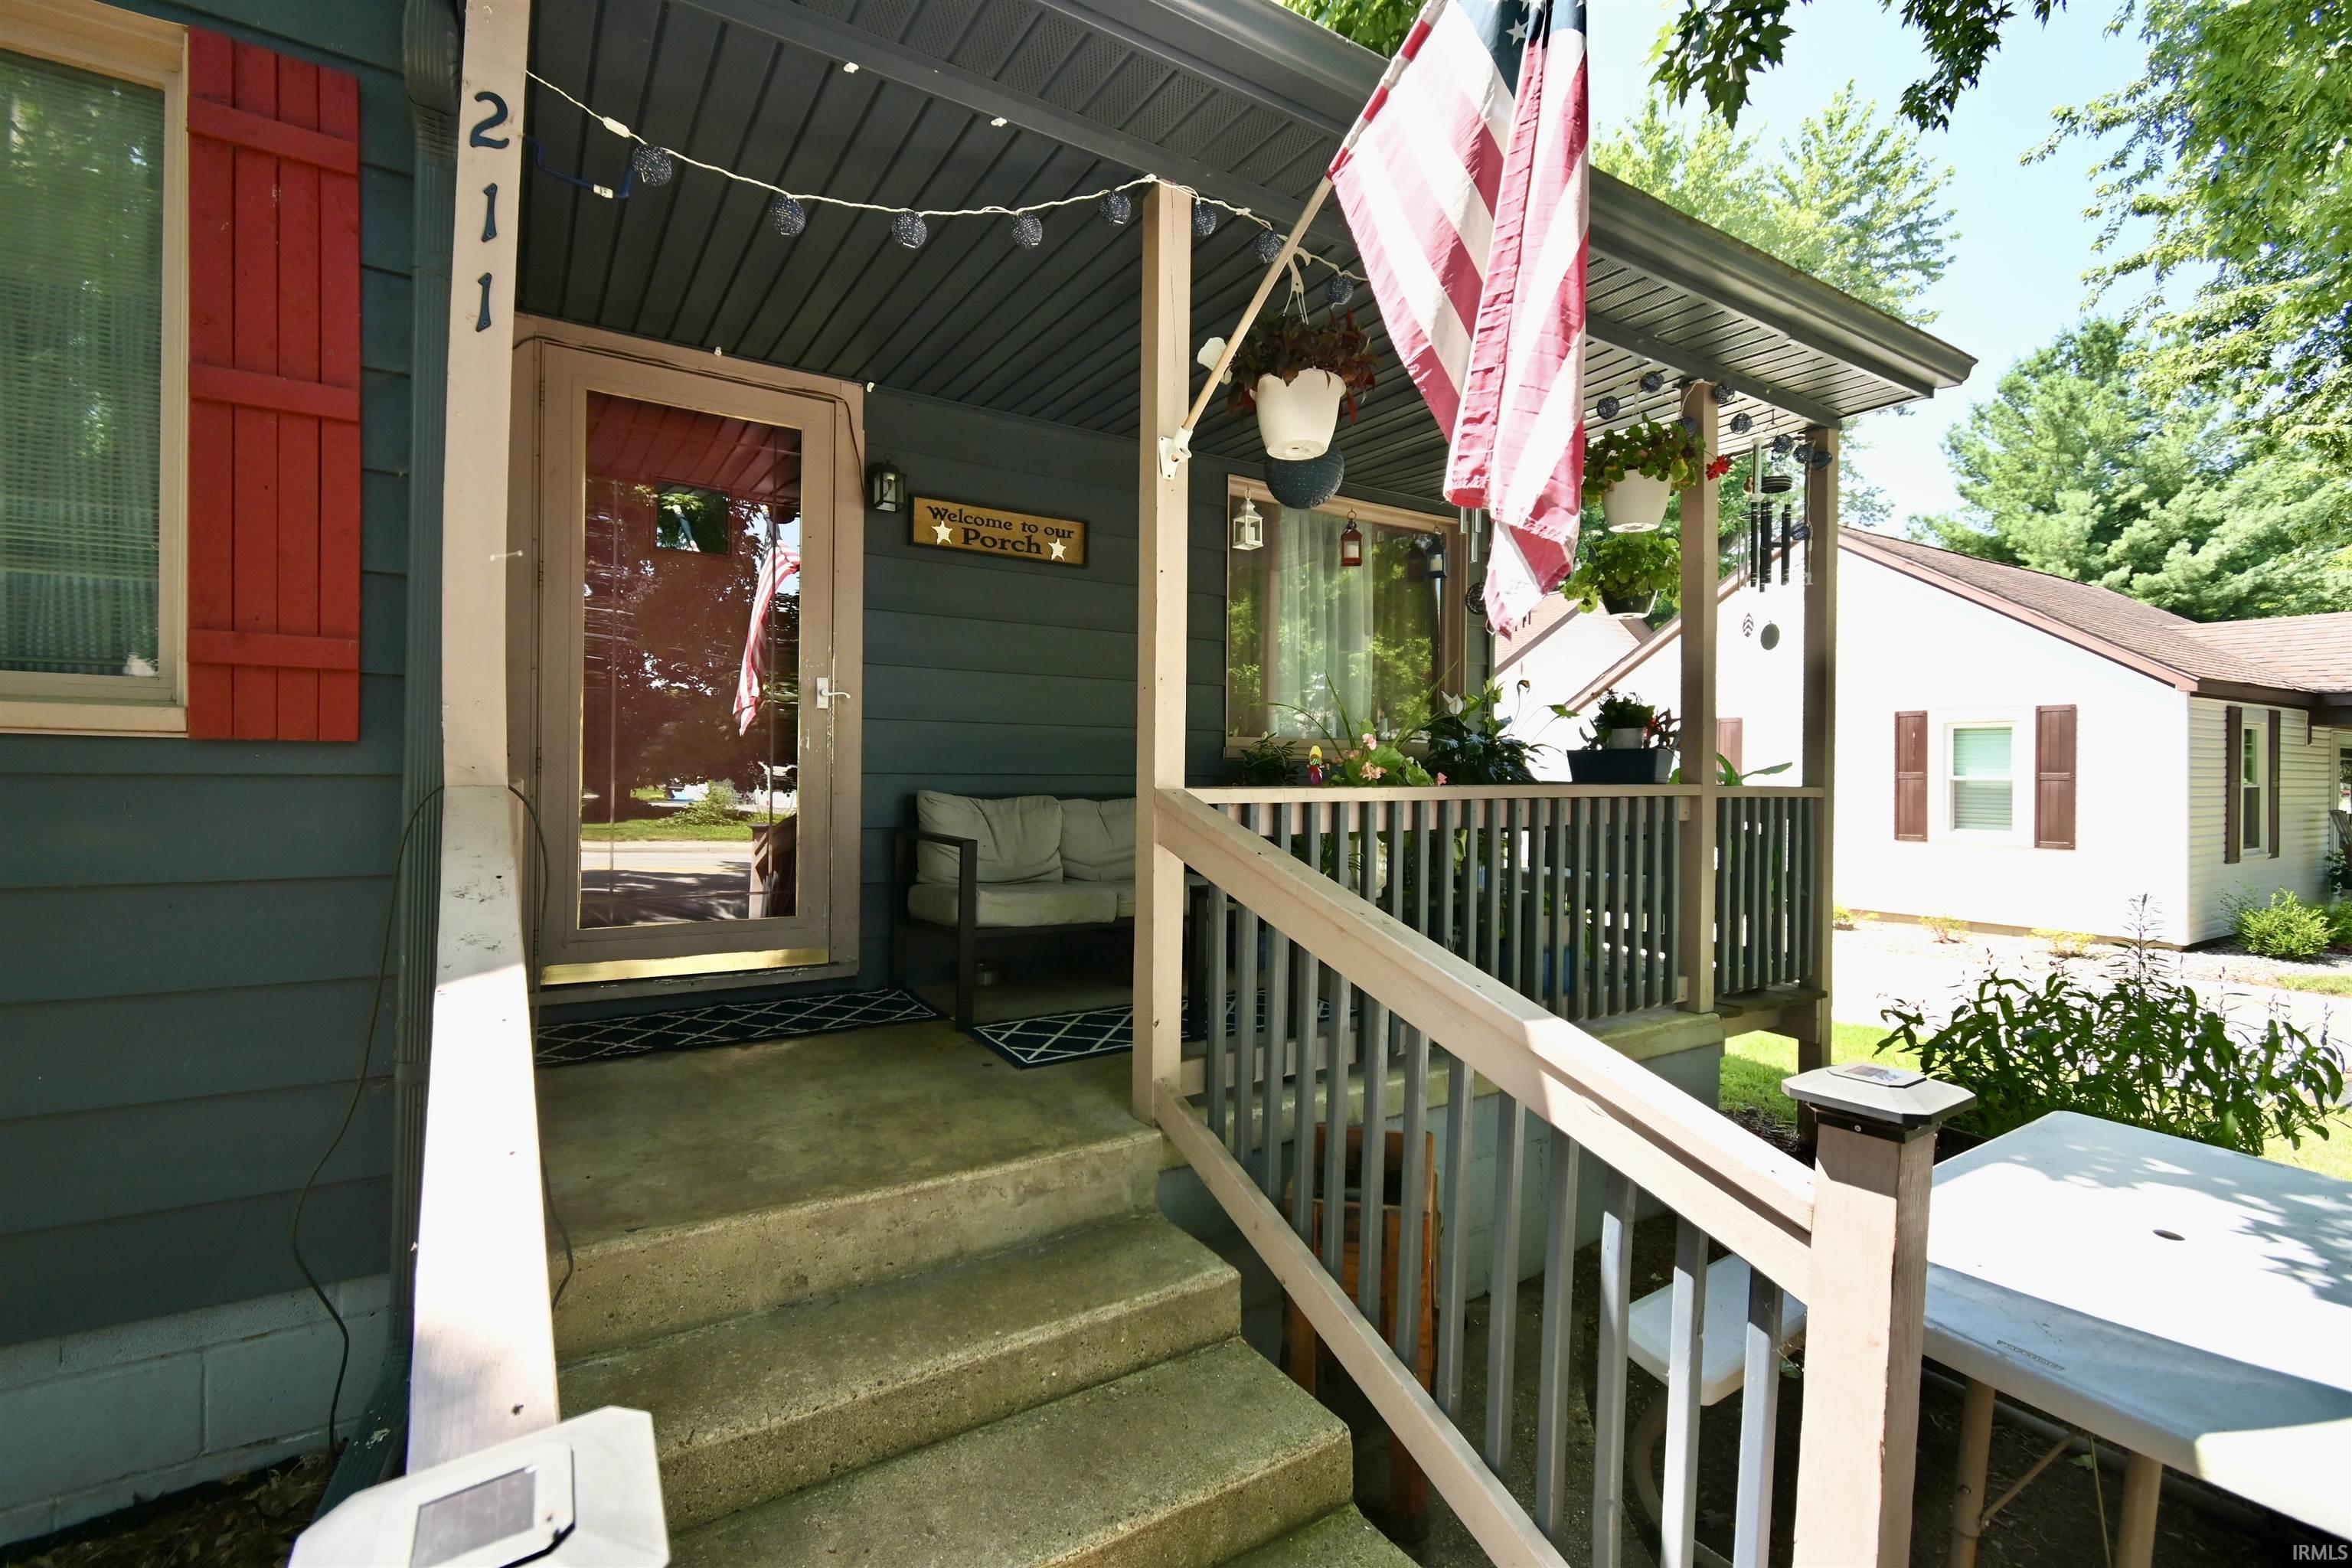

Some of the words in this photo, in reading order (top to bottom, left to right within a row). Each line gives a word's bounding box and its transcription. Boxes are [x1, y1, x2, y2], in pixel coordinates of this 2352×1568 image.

[470, 91, 510, 332] 211
[926, 505, 1013, 531] Welcome
[1021, 521, 1039, 534] to
[1044, 526, 1075, 539] our
[961, 527, 1043, 555] Porch
